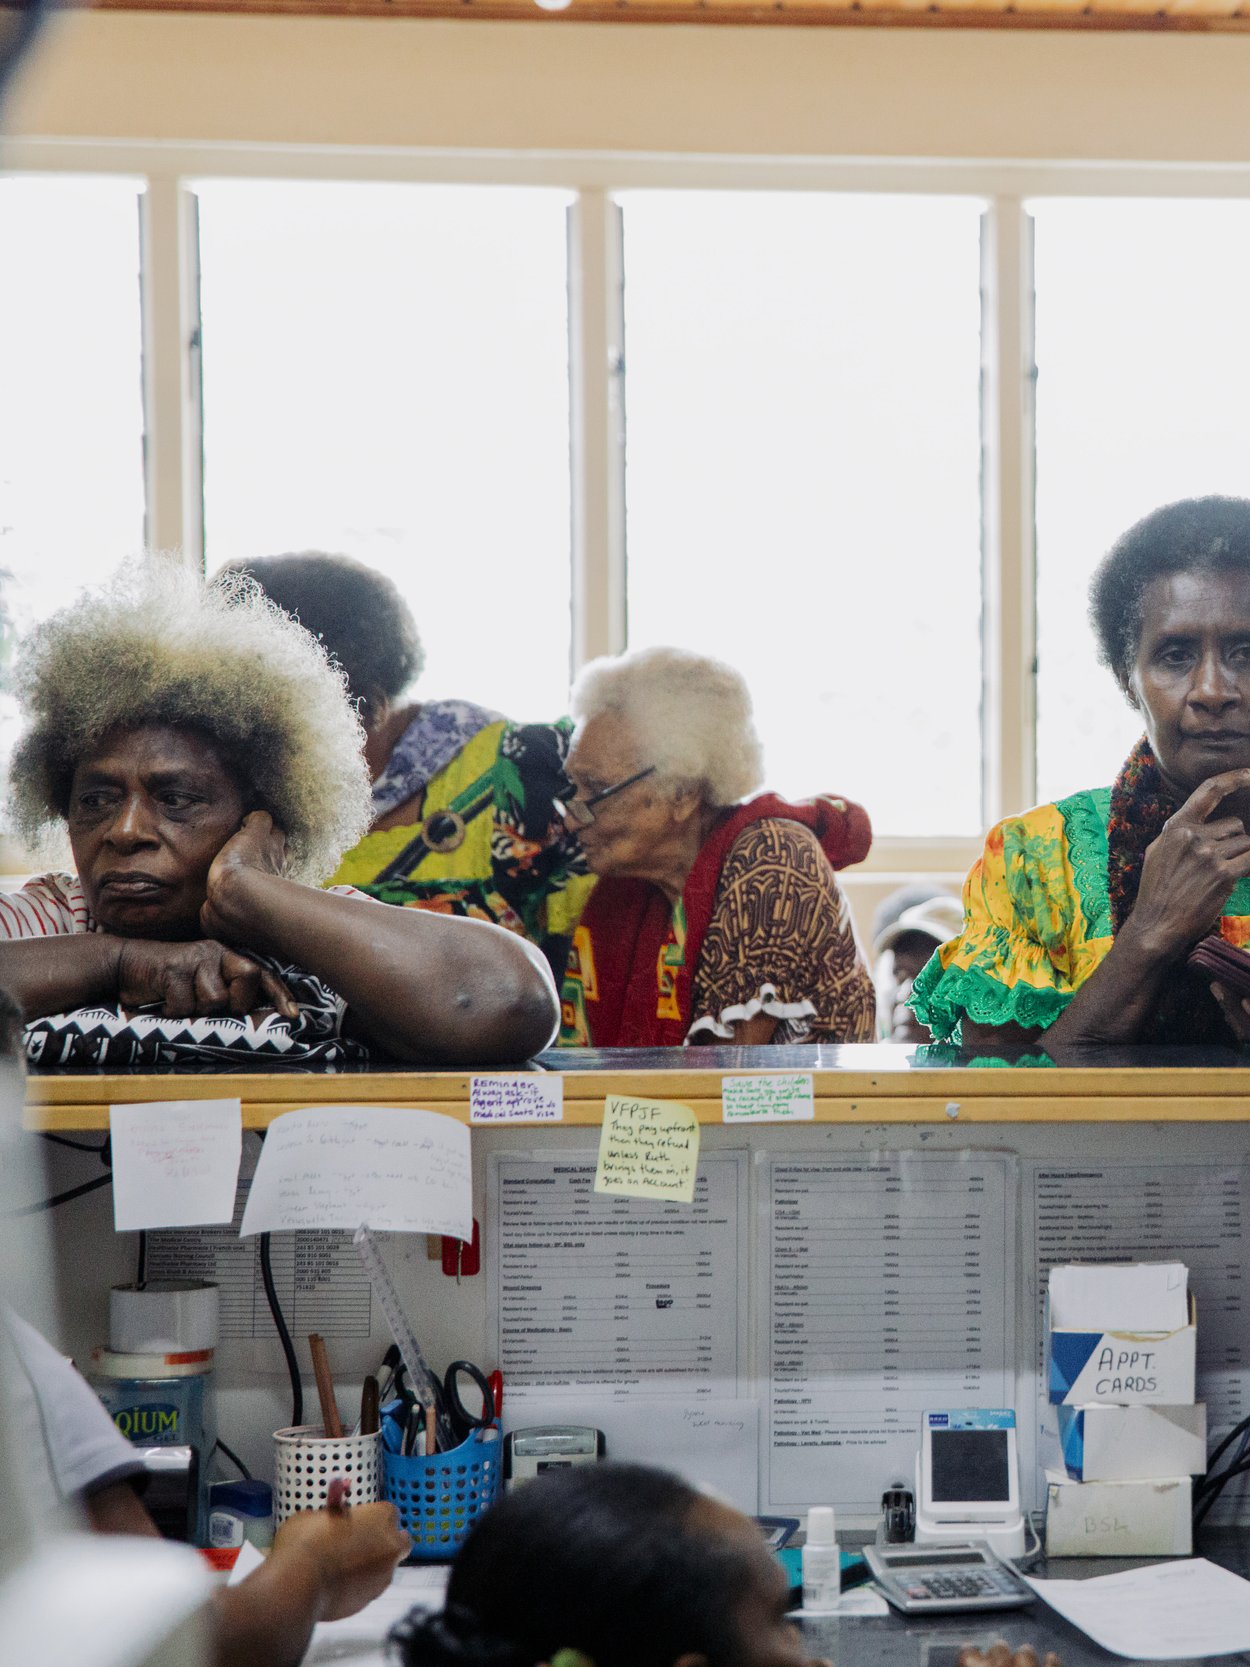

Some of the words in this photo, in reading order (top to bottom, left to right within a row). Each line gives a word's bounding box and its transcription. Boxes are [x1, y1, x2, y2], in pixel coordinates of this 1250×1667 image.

[639, 1124, 657, 1135] pay
[660, 1121, 696, 1134] upfront
[634, 1138, 655, 1149] they
[657, 1137, 690, 1150] refund
[607, 1149, 639, 1160] unless
[603, 1161, 636, 1175] brings
[640, 1163, 663, 1174] them
[603, 1176, 624, 1187] goes
[1096, 1376, 1157, 1395] CARDS
